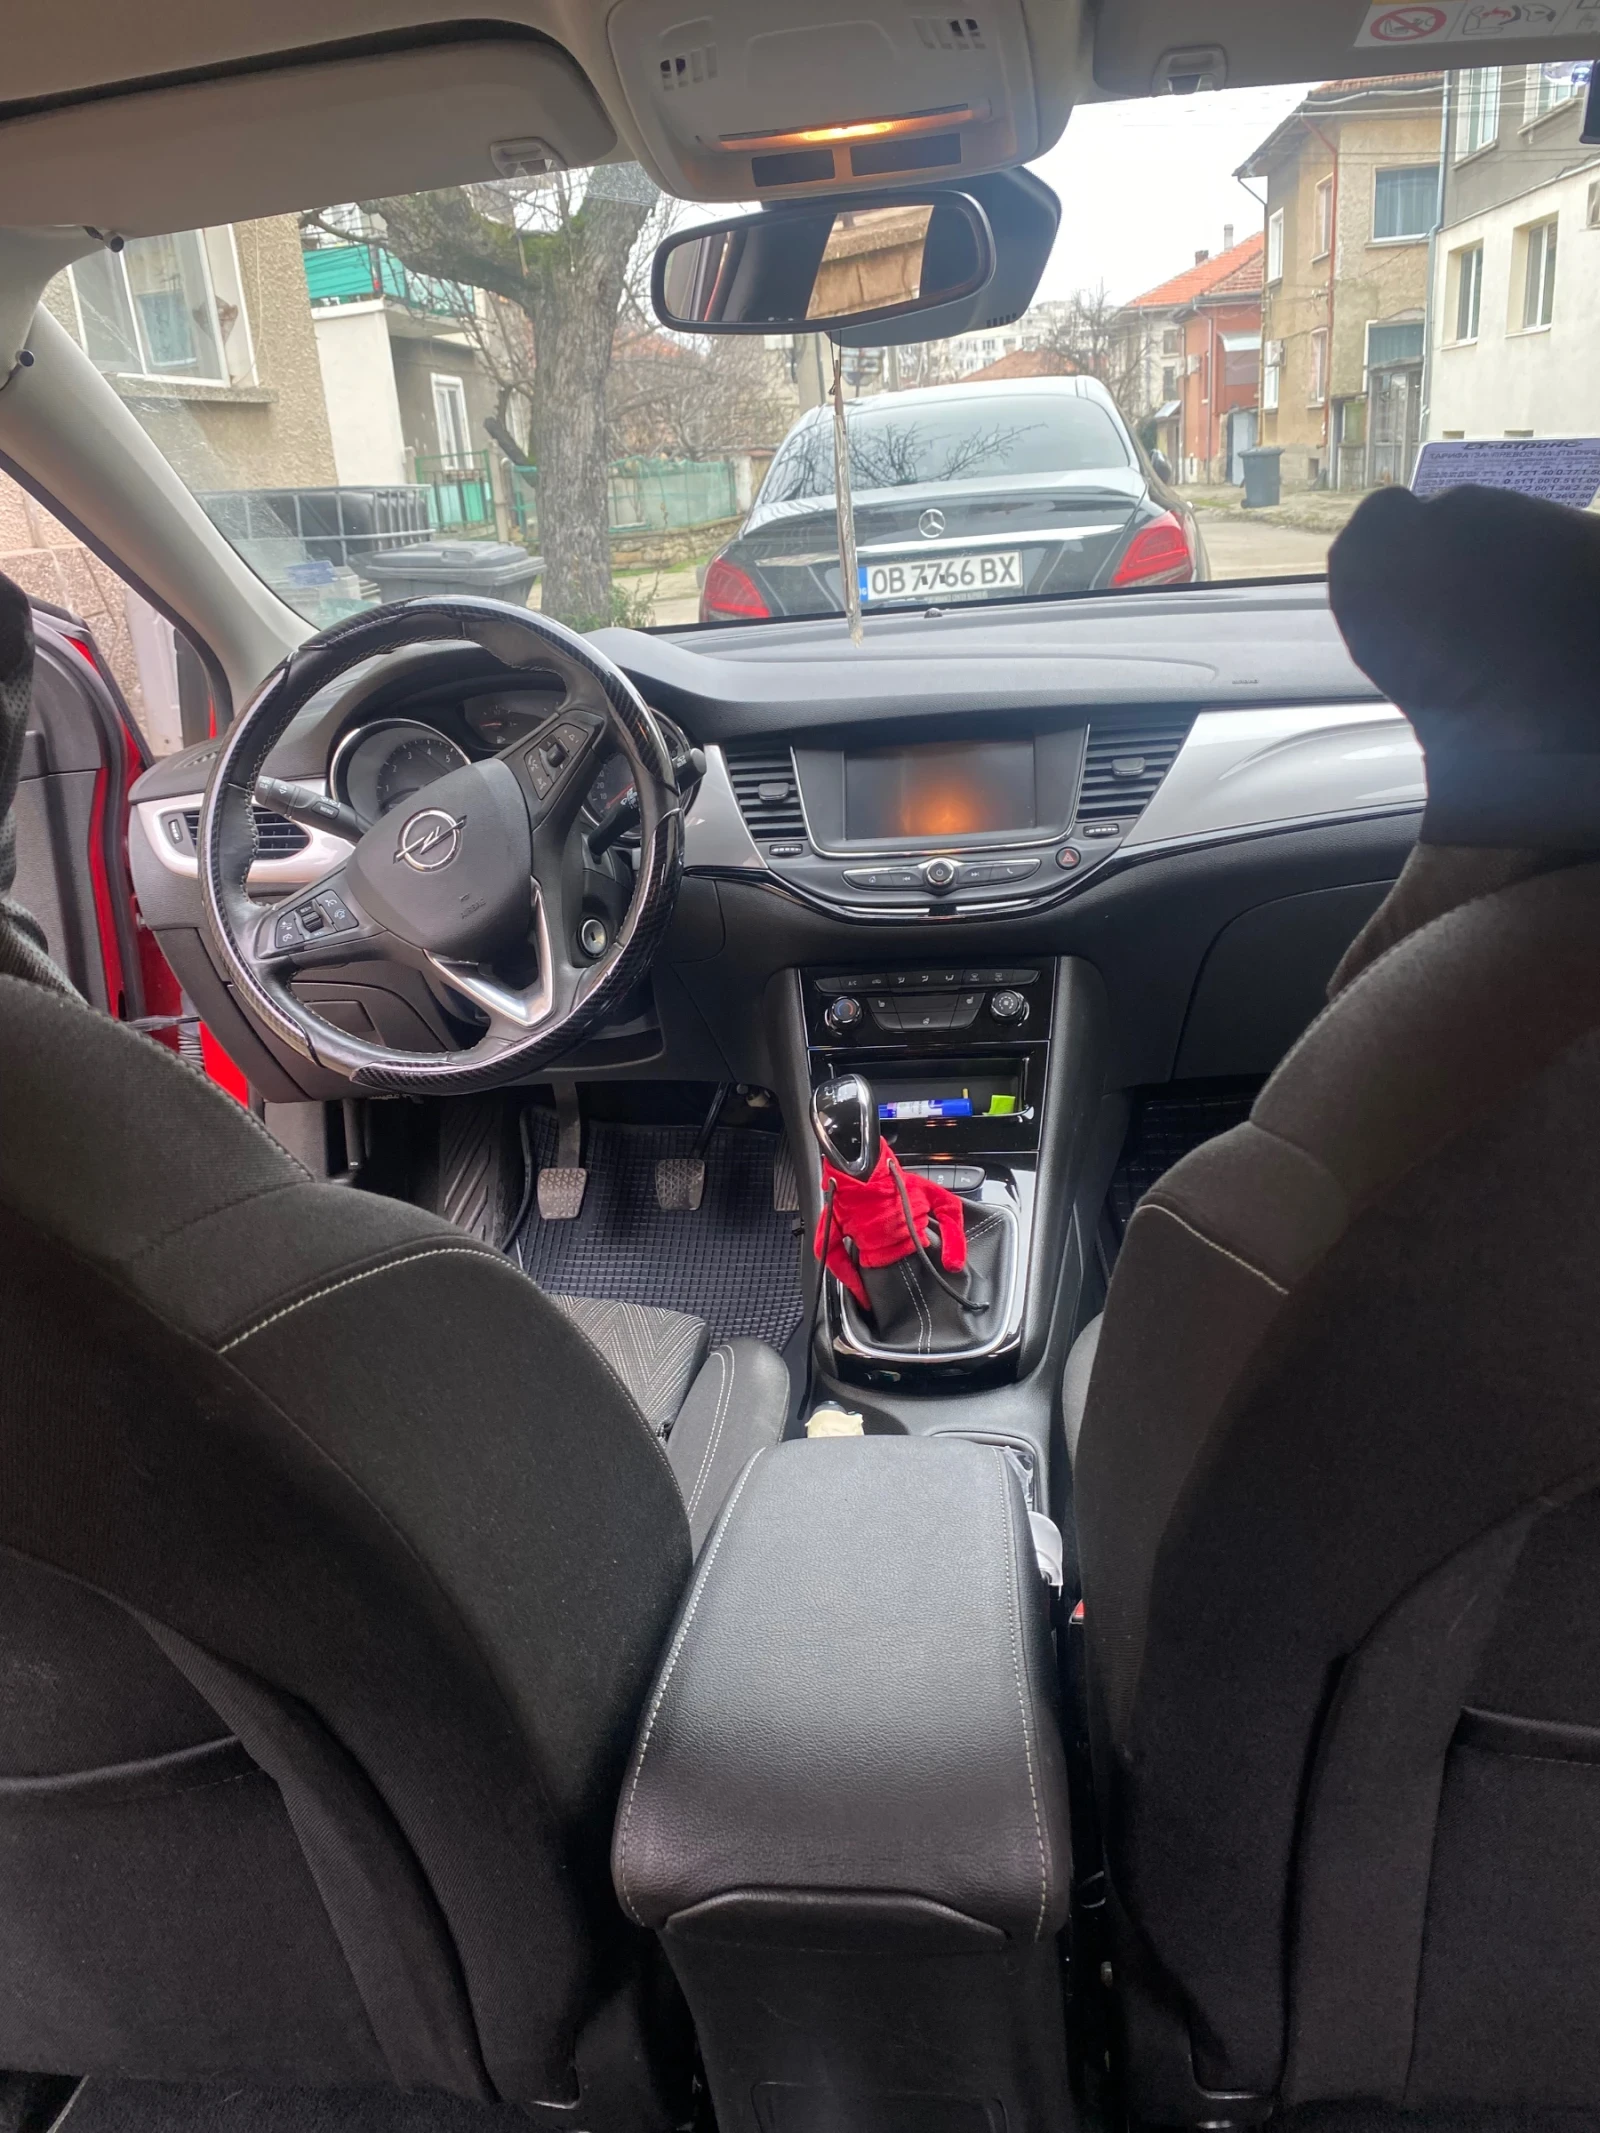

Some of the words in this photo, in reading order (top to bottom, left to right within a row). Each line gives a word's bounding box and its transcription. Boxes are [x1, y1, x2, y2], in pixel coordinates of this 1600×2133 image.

[872, 568, 906, 594] OB
[911, 559, 975, 592] 7766
[981, 555, 1015, 585] BX
[407, 751, 413, 760] 3
[426, 748, 432, 756] 4
[445, 754, 451, 763] 5
[385, 784, 389, 792] 1
